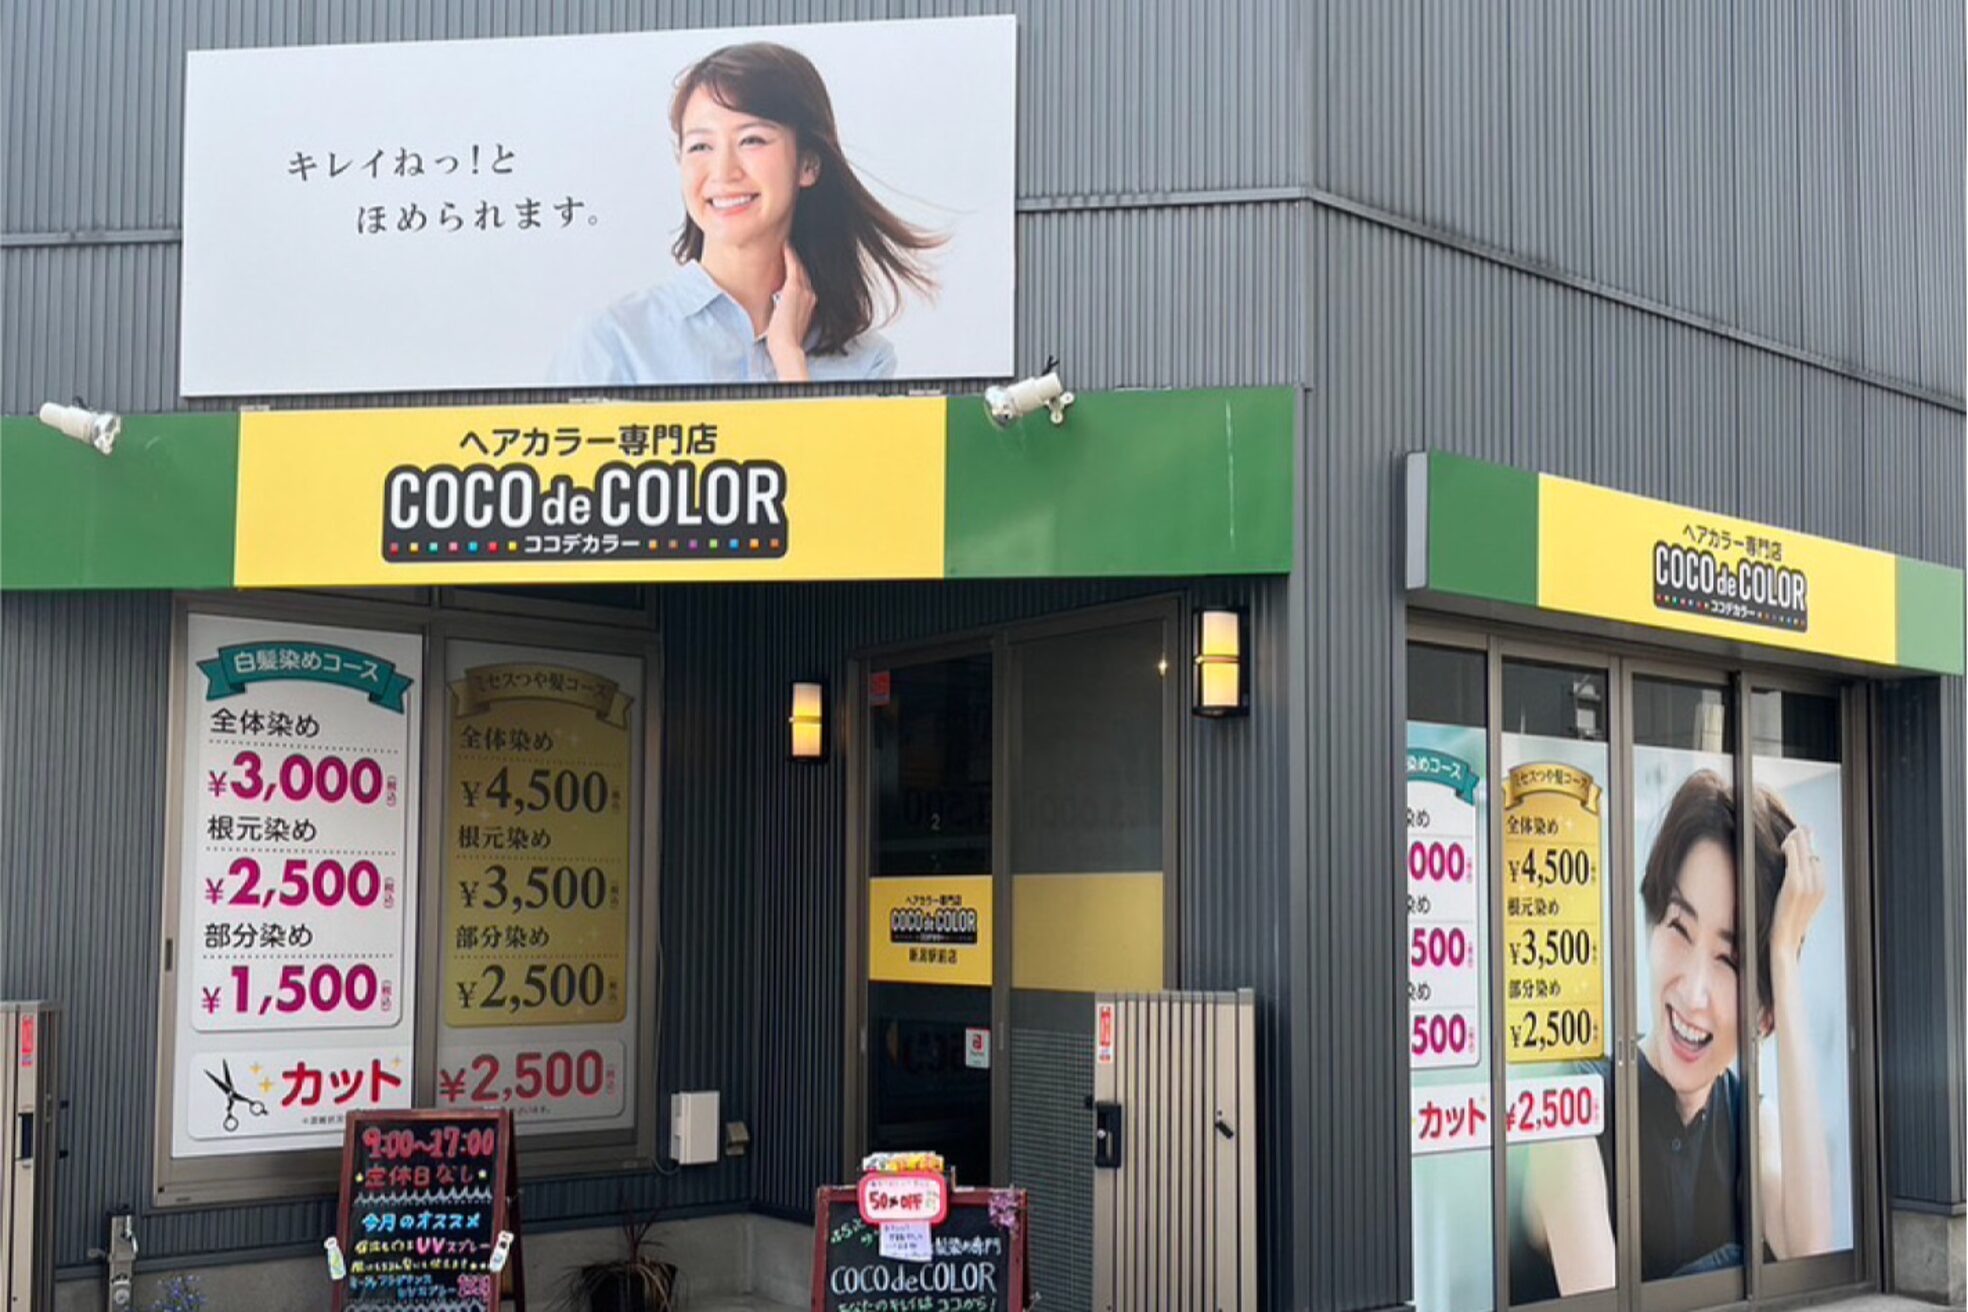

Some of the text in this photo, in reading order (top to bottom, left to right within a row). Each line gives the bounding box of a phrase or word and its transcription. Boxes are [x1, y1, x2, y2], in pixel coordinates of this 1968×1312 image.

[356, 195, 599, 235] ほめられます。
[459, 423, 719, 458] ヘアカラー専門店
[390, 465, 781, 530] COCO de COLOR
[523, 532, 641, 555] ココデカラー
[1681, 524, 1783, 563] ヘアカラー専門店
[1655, 544, 1806, 613] COCO de COLOR
[1710, 600, 1756, 619] ココデカラー
[233, 648, 380, 682] 白髪染めコース
[210, 707, 321, 738] 全体染め
[460, 726, 555, 751] 全体染め
[207, 750, 384, 805] ¥3,000
[460, 766, 609, 816] ¥4,500
[207, 814, 317, 842] 根元染め
[457, 825, 551, 850] 根元染め
[1506, 815, 1559, 836] 全体染め
[205, 856, 381, 909] ¥2,500
[1508, 848, 1590, 888] ¥4,500
[459, 864, 607, 915] ¥3,500
[1507, 896, 1560, 917] 根元染め
[203, 922, 314, 949] 部分染め
[456, 924, 550, 949] 部分染め
[935, 910, 976, 933] COLOR
[1509, 928, 1591, 970] ¥3,500
[202, 963, 378, 1016] ¥1,500
[456, 962, 605, 1014] ¥2,500
[1508, 979, 1561, 999] 部分染め
[1510, 1008, 1592, 1052] ¥2,500
[281, 1058, 403, 1108] カット
[439, 1049, 605, 1103] ¥2,500
[1418, 1097, 1488, 1140] カット
[364, 1163, 474, 1189] 定休日なし
[361, 1210, 481, 1233] 今月のオススメ
[829, 1261, 998, 1295] COCO de COLOR
